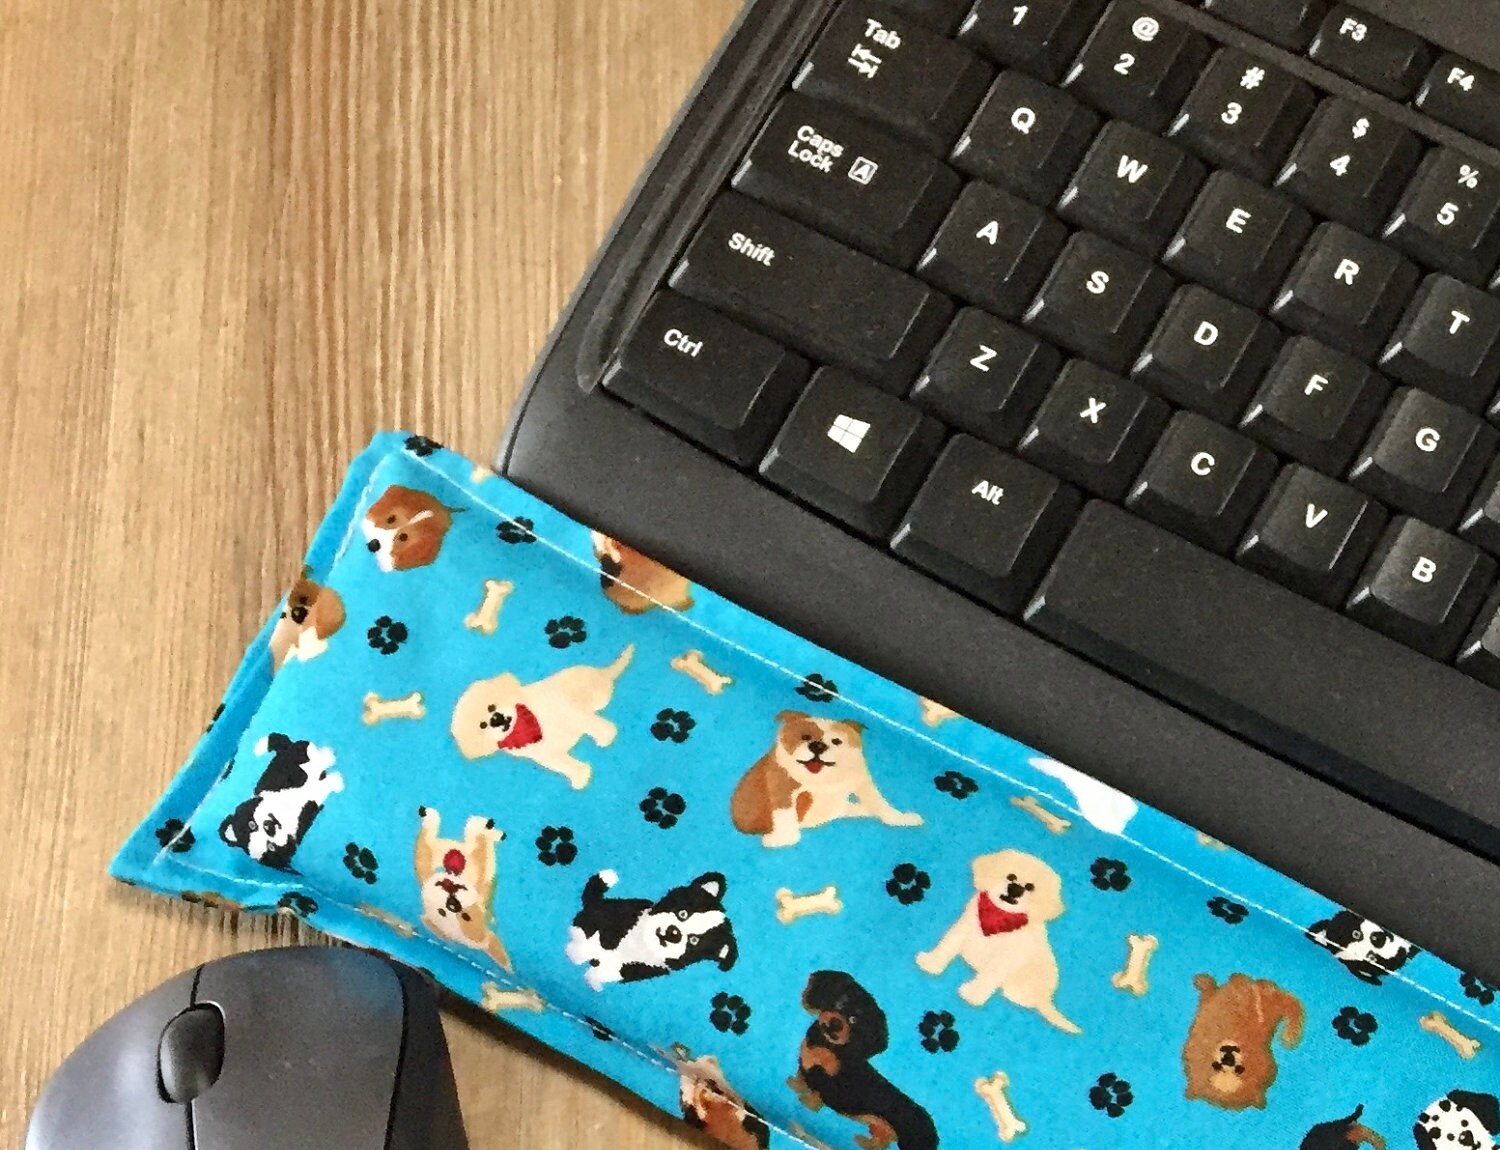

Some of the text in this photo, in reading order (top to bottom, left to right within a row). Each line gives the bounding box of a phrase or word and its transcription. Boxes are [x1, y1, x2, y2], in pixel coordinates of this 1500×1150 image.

[1012, 5, 1029, 26] 1
[865, 18, 901, 49] Tab
[1131, 16, 1160, 42] @
[1339, 17, 1368, 42] F3
[1113, 52, 1136, 75] 2
[1239, 66, 1265, 90] #
[1447, 67, 1475, 92] F4
[1010, 106, 1036, 135] Q
[1220, 101, 1243, 125] 3
[795, 123, 845, 158] Caps
[1351, 118, 1370, 139] $
[787, 140, 834, 173] Lock
[1116, 154, 1149, 184] W
[1329, 154, 1351, 177] 4
[1457, 164, 1479, 189] %
[1225, 207, 1252, 234] E
[1436, 202, 1459, 226] 5
[975, 220, 999, 245] A
[728, 232, 775, 266] Shift
[1086, 270, 1110, 294] S
[1334, 258, 1360, 286] R
[1193, 320, 1219, 346] D
[1449, 310, 1471, 335] T
[663, 328, 704, 357] Ctrl
[969, 344, 998, 372] Z
[1304, 374, 1329, 396] F
[1079, 397, 1107, 424] X
[1415, 427, 1440, 452] G
[1190, 451, 1215, 476] C
[971, 480, 1004, 505] Alt
[1305, 503, 1328, 529] V
[1411, 556, 1437, 583] B
